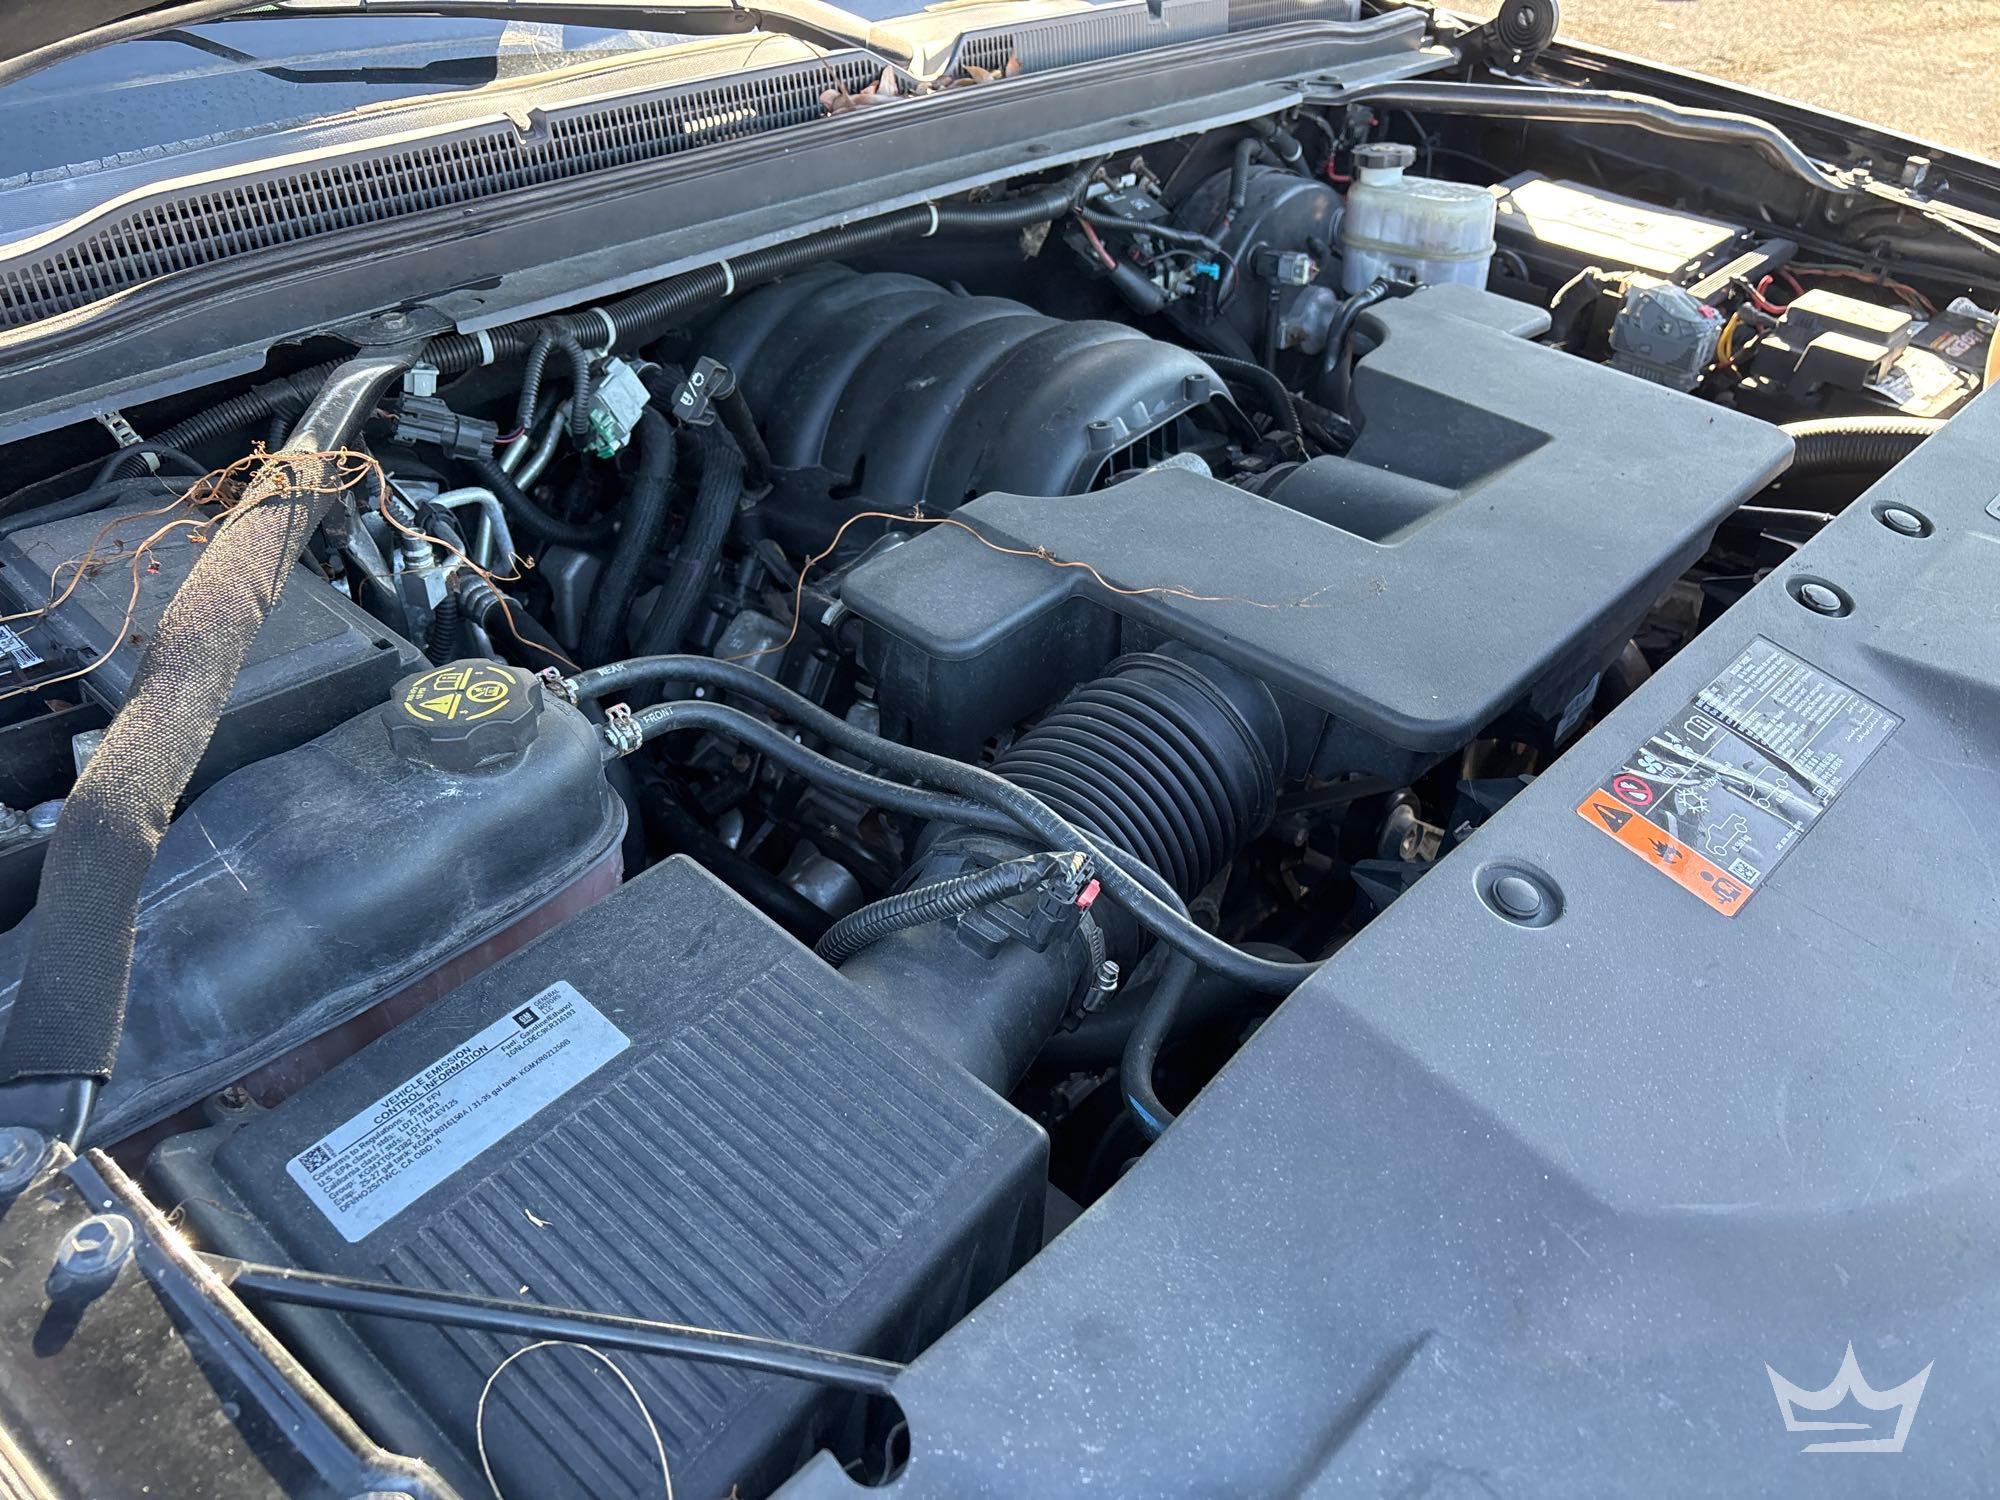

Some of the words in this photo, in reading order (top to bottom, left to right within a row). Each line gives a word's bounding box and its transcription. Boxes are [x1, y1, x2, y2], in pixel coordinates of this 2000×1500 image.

[596, 663, 627, 677] REAR
[643, 706, 674, 724] FRONT
[532, 987, 559, 1007] GENERAL
[537, 993, 562, 1011] MOTORS
[541, 1004, 554, 1015] LLC
[500, 1038, 519, 1052] Fuel:
[518, 1001, 573, 1040] Gasoline/Ethanol
[372, 1087, 424, 1125] CONTROL
[421, 1044, 489, 1091] INFORMATION
[380, 1076, 426, 1109] VEHICLE
[423, 1045, 472, 1080] EMISSION
[311, 1152, 351, 1182] Conforms
[348, 1146, 360, 1156] to
[357, 1115, 406, 1150] Regulations:
[405, 1101, 426, 1116] 2019
[425, 1089, 443, 1103] FFV
[316, 1174, 334, 1188] U.S.
[333, 1161, 352, 1176] EPA
[350, 1147, 374, 1165] class
[375, 1131, 396, 1148] stds:
[397, 1118, 415, 1133] LDT
[416, 1100, 441, 1119] TIER3
[321, 1165, 361, 1194] California
[358, 1150, 382, 1169] class
[383, 1135, 404, 1152] stds:
[405, 1122, 423, 1137] LDT
[424, 1097, 459, 1123] ULEV125
[327, 1178, 357, 1201] Group:
[413, 1125, 432, 1140] 5.3L
[332, 1187, 358, 1207] Evap:
[357, 1170, 381, 1188] 25-27
[379, 1160, 395, 1174] gal
[391, 1147, 413, 1164] tank:
[470, 1092, 492, 1109] 31-35
[489, 1084, 504, 1097] gal
[500, 1073, 520, 1088] tank:
[399, 1156, 415, 1169] CA
